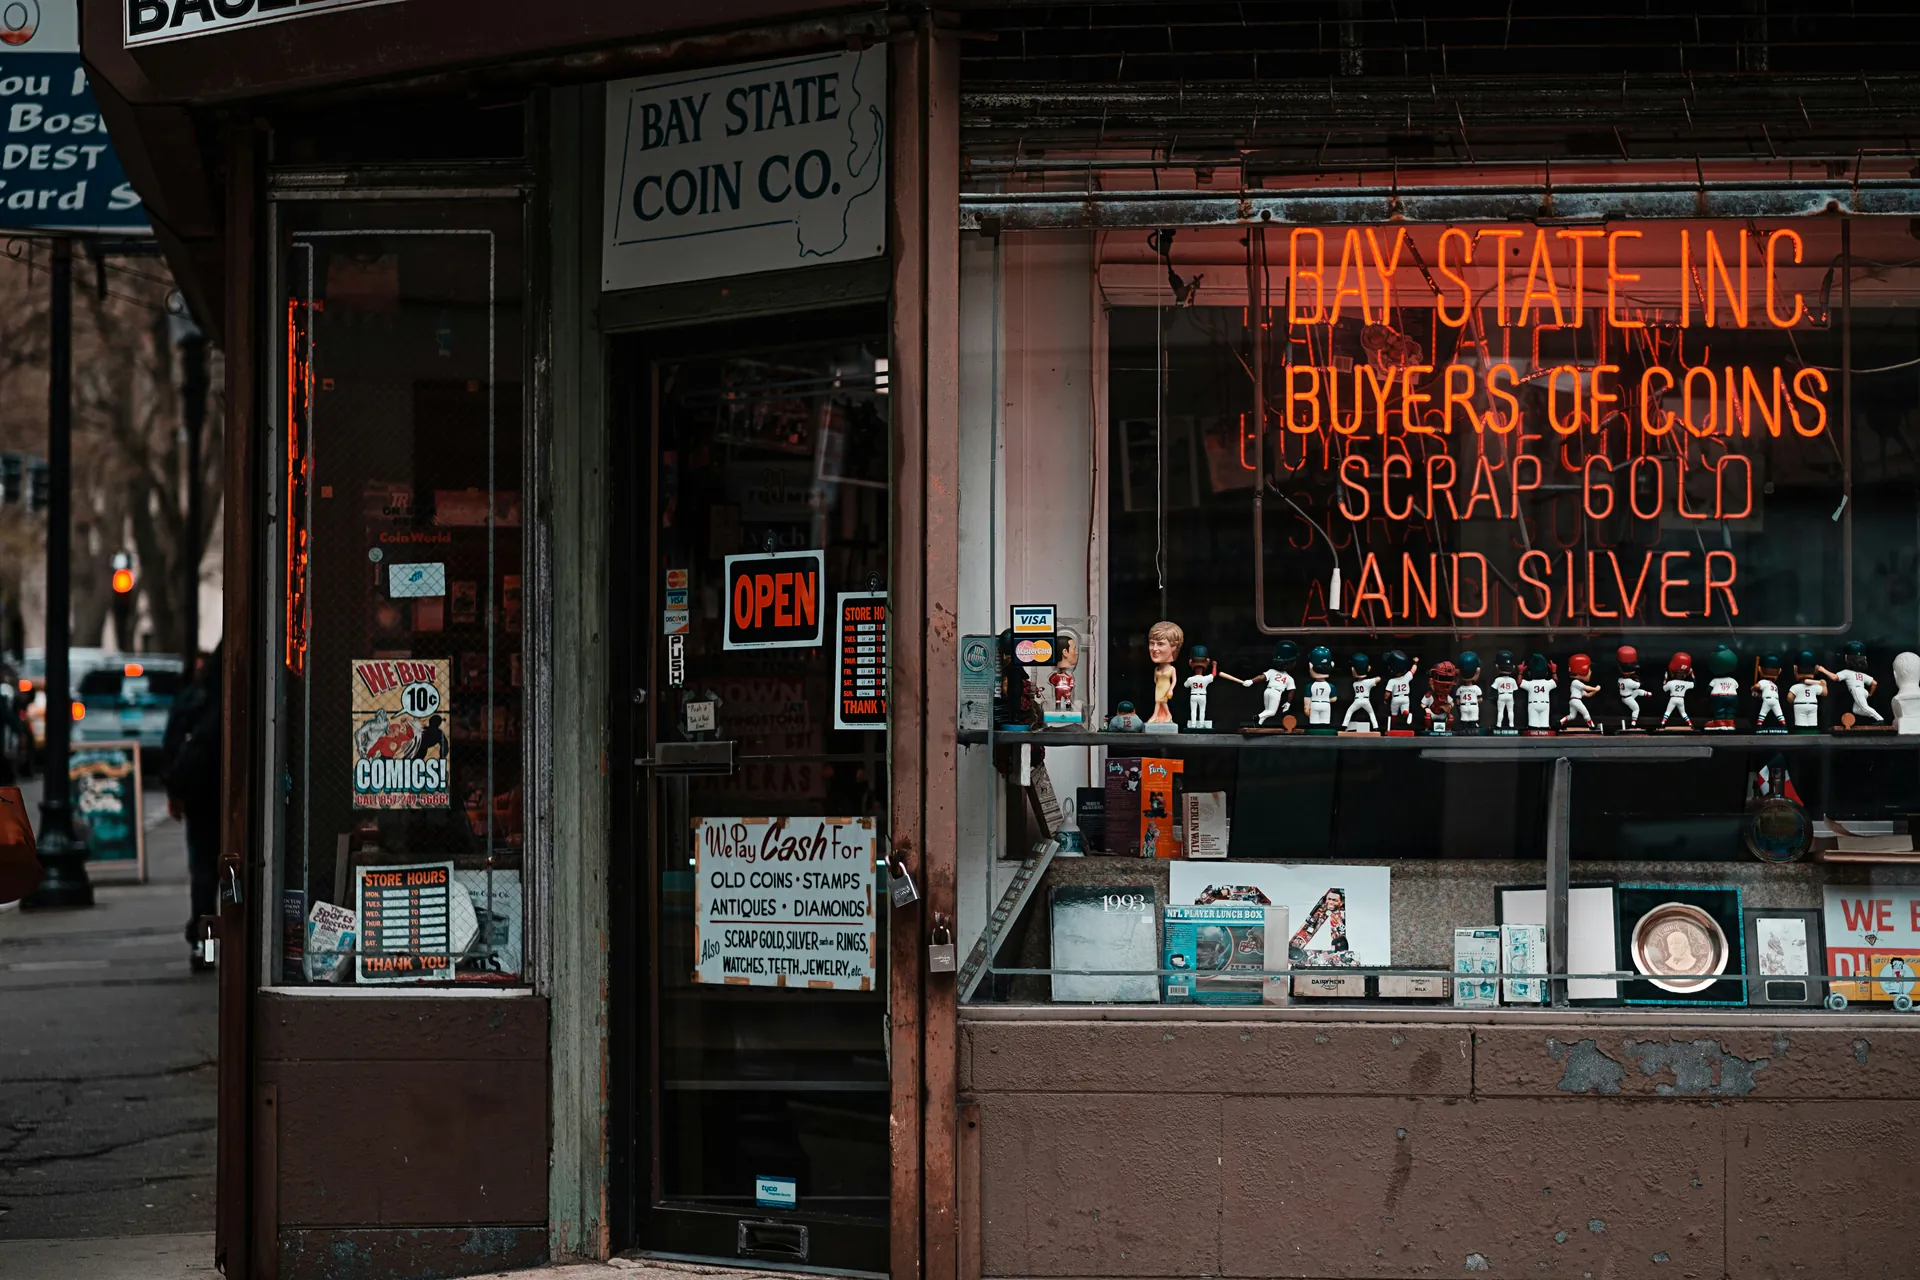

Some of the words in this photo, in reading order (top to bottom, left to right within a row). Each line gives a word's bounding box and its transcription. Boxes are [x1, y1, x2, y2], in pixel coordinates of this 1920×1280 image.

[0, 66, 51, 96] ou
[640, 92, 711, 151] BAY
[725, 72, 841, 137] STATE
[0, 144, 107, 171] DEST
[633, 161, 743, 221] COIN
[758, 149, 841, 203] CO.
[1288, 226, 1407, 329] BAY
[1437, 227, 1644, 329] STATE
[1681, 228, 1804, 329] INC
[1285, 364, 1520, 436] BUYERS
[1548, 364, 1621, 436] OF
[1640, 365, 1829, 438] COINS
[1338, 454, 1543, 522] SCRAP
[1584, 454, 1754, 521] GOLD
[1351, 551, 1489, 620] AND
[1517, 549, 1740, 620] SILVER
[734, 571, 815, 630] OPEN
[844, 606, 871, 621] STORE
[1021, 616, 1047, 625] VISA
[967, 653, 986, 664] LOUIS
[973, 646, 985, 655] JOE
[1016, 646, 1052, 656] MasterCard
[671, 636, 682, 684] PUSH
[355, 662, 398, 697] WE
[394, 662, 436, 687] BUY
[1274, 674, 1287, 684] 24
[1855, 673, 1864, 681] 18
[1315, 688, 1325, 696] 17
[1355, 685, 1364, 693] 50
[1397, 684, 1407, 692] 12
[1533, 685, 1545, 693] 34
[1674, 684, 1685, 692] 27
[1804, 689, 1811, 697] 5
[1462, 693, 1472, 701] 45
[843, 699, 877, 715] THANK
[355, 758, 447, 793] COMICS!
[1108, 763, 1124, 775] Furby
[1148, 764, 1167, 779] Furby
[357, 794, 378, 805] CALL
[1190, 801, 1199, 832] BERLIN
[705, 823, 733, 858] We
[730, 823, 756, 863] Pay
[760, 822, 828, 861] Cash
[832, 825, 863, 859] For
[1190, 833, 1199, 854] WALL
[365, 873, 403, 887] STORE
[407, 869, 447, 885] HOURS
[711, 871, 745, 888] OLD
[750, 872, 793, 888] COINS
[803, 872, 860, 889] STAMPS
[330, 906, 344, 914] The
[710, 898, 776, 918] ANTIQUES
[794, 900, 865, 917] DIAMONDS
[1100, 894, 1146, 912] 1993
[317, 907, 354, 924] Sports
[1167, 909, 1182, 918] NFL
[1184, 909, 1215, 918] PLAYER
[1216, 909, 1243, 918] LUNCH
[1244, 910, 1263, 919] BOX
[1840, 899, 1894, 932] WE
[313, 915, 355, 931] Collectors
[320, 925, 339, 933] Bible
[724, 929, 758, 948] SCRAP
[836, 932, 869, 954] RINGS,
[701, 939, 720, 965] Also
[364, 956, 413, 971] THANK
[418, 955, 447, 969] YOU
[723, 956, 768, 976] WATCHES,
[761, 1185, 778, 1193] tyco
